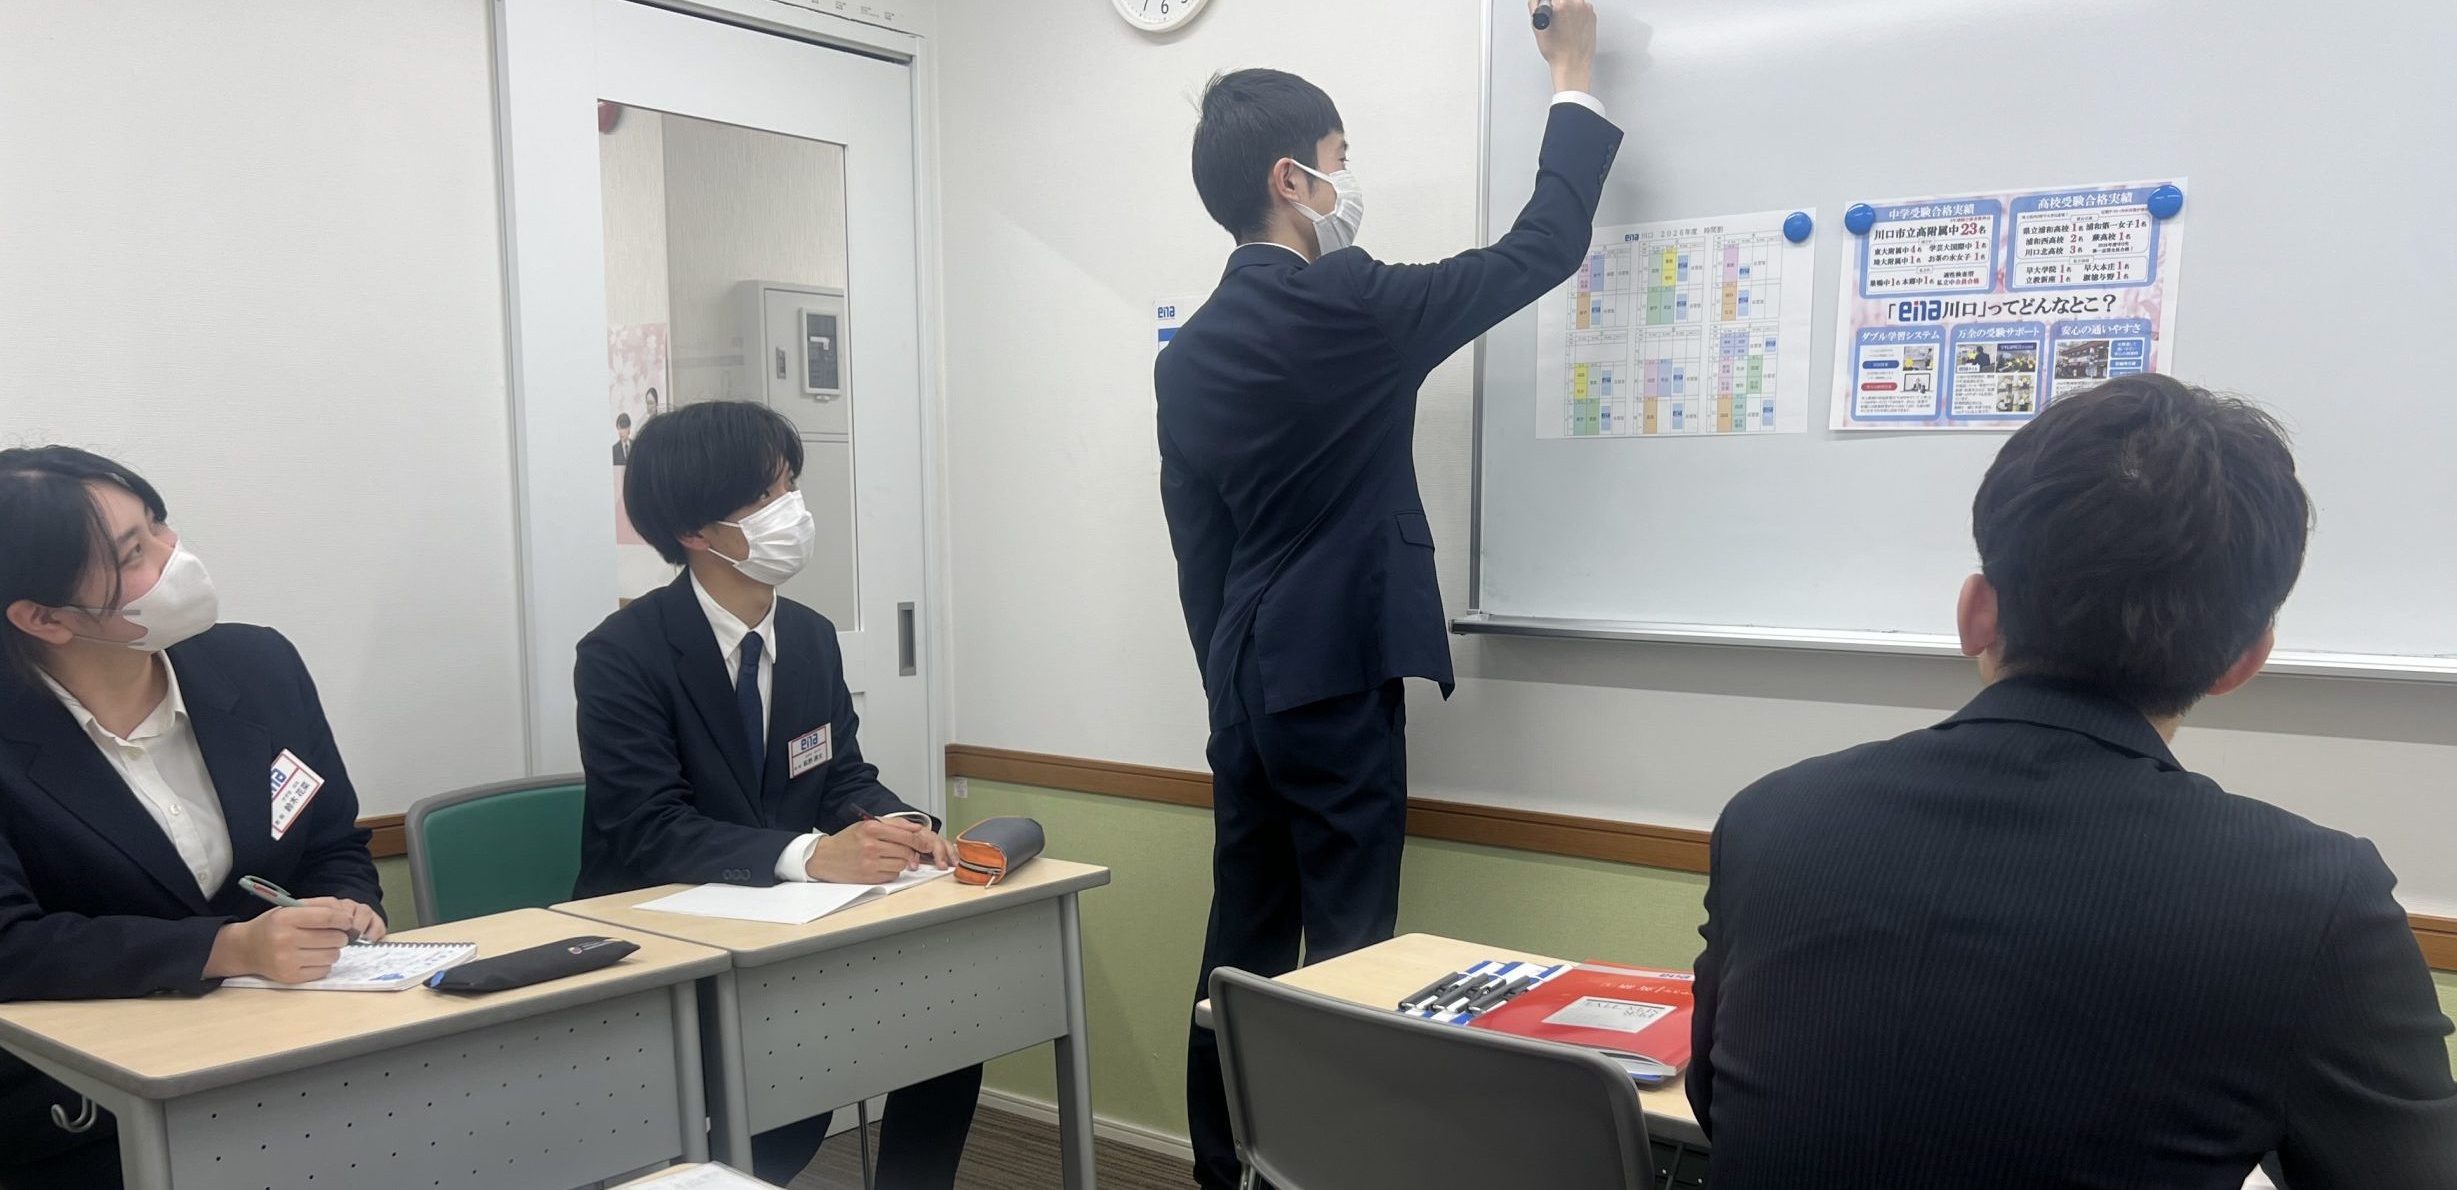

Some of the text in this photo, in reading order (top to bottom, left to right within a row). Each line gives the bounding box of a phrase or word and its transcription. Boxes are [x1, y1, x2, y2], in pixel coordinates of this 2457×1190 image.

[2038, 192, 2133, 210] 高校受験合格実績
[1888, 203, 1975, 220] 中学受験合格実績
[1157, 305, 1176, 319] ena
[1862, 330, 1940, 342] ダブル学習システム
[1957, 326, 2040, 339] 万全の受験サポート
[2062, 323, 2142, 336] 安心の通いやすさ
[800, 732, 819, 751] ena
